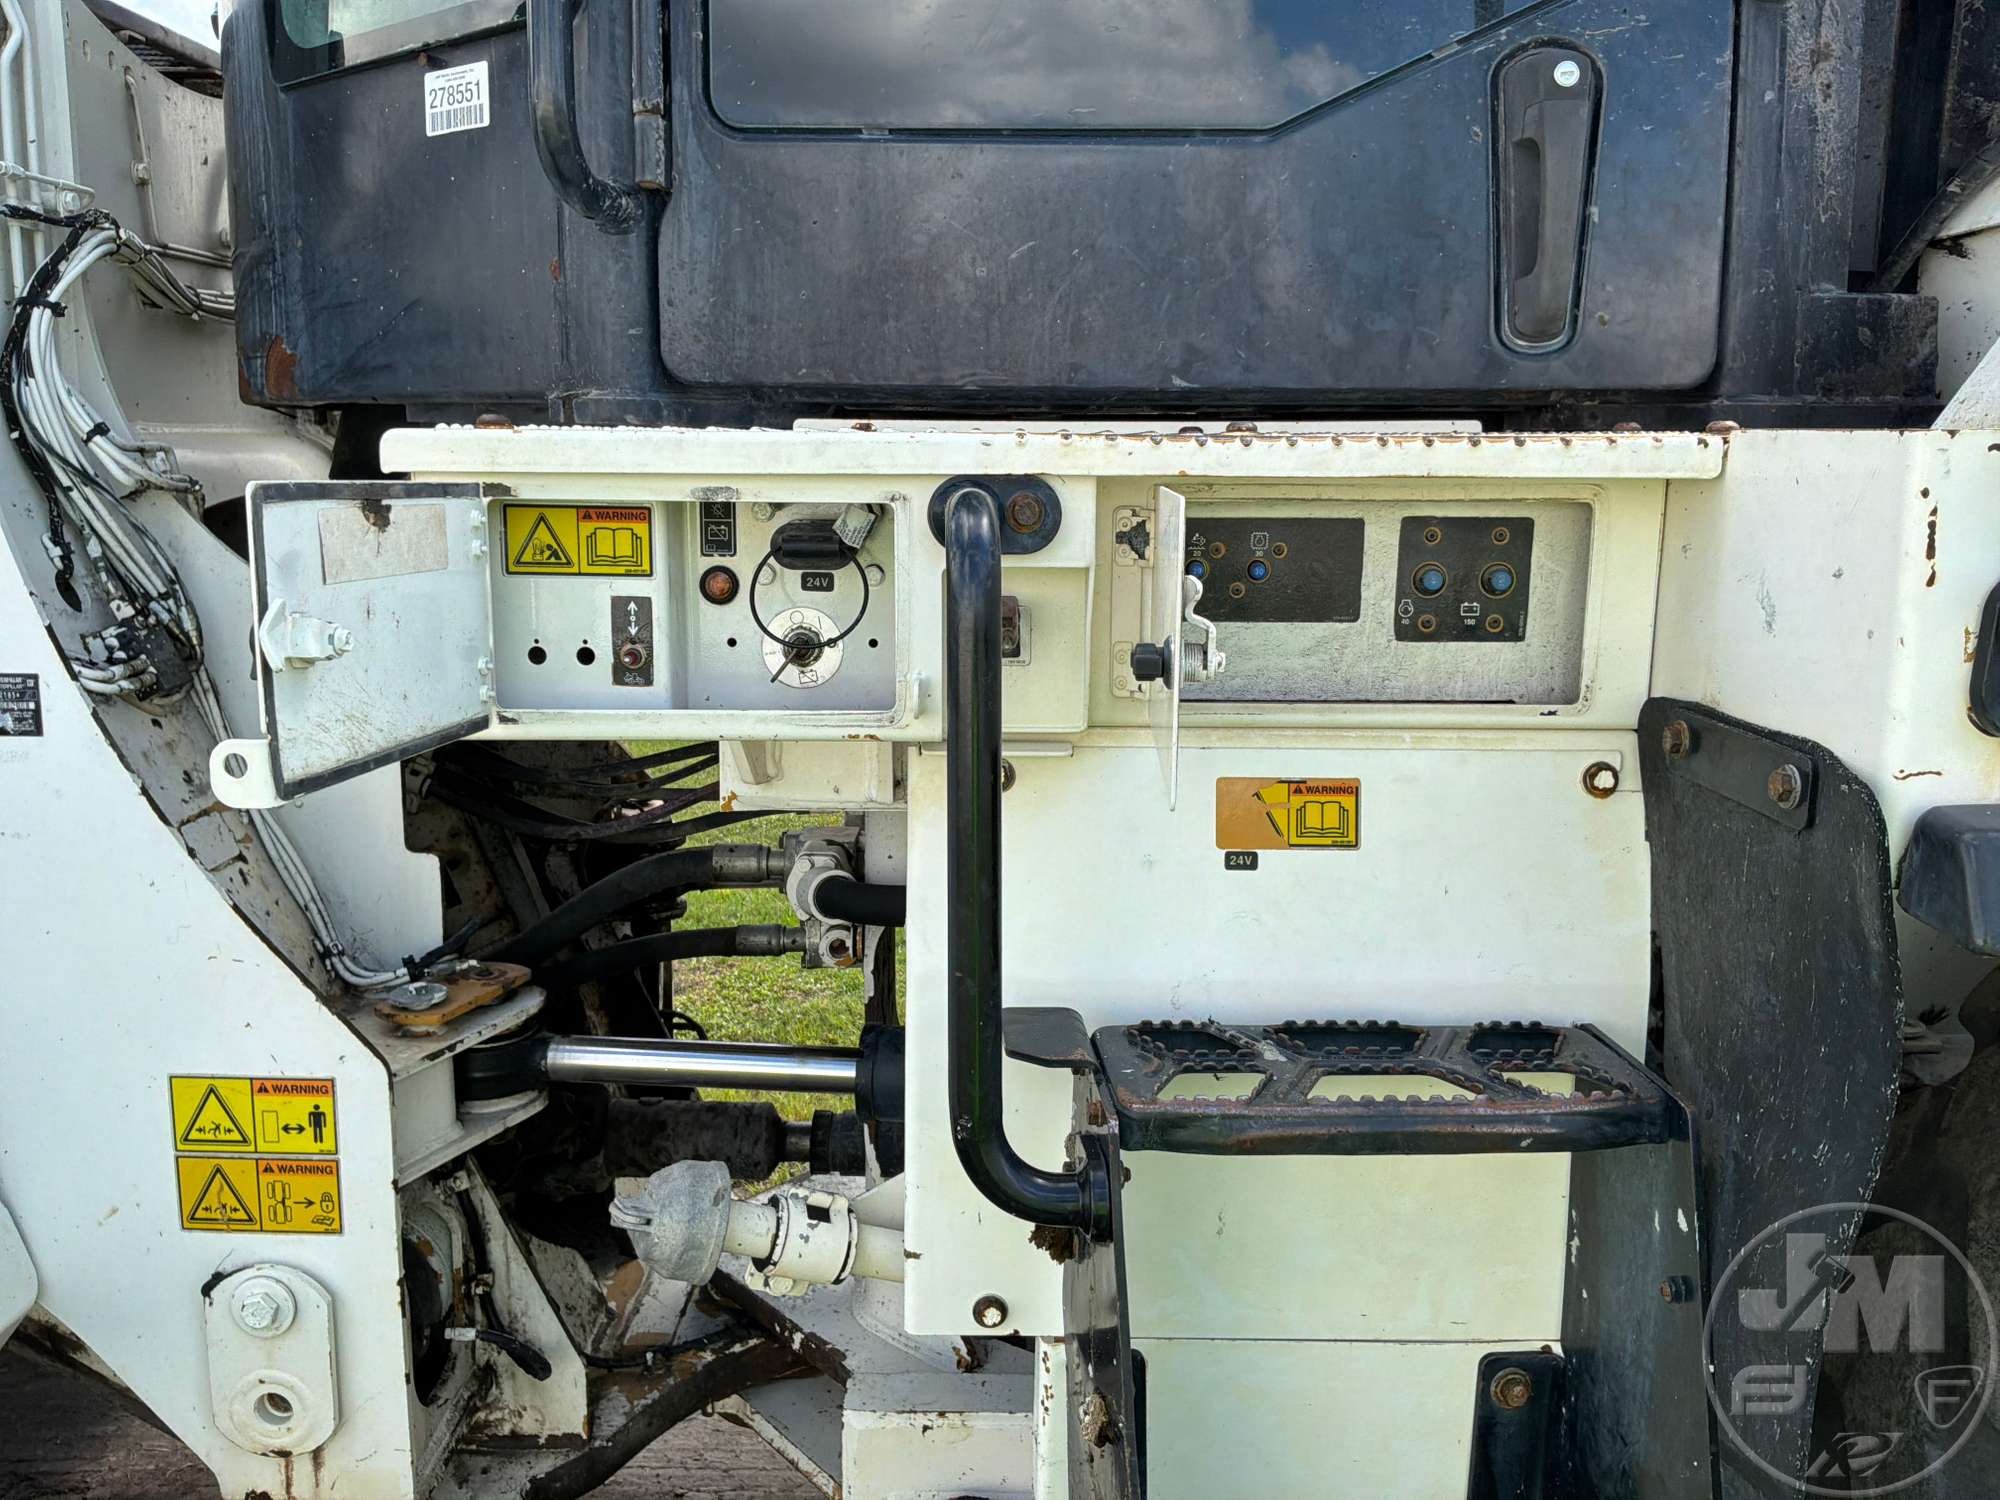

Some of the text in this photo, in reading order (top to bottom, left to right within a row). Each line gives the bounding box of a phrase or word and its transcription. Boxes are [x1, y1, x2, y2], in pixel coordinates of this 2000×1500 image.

[429, 80, 480, 109] 278551
[595, 511, 647, 521] WARNING
[806, 577, 829, 587] 24V
[1305, 785, 1354, 795] WARNING
[1230, 855, 1253, 866] 24V
[272, 1084, 329, 1095] WARNING
[276, 1164, 334, 1175] WARNING
